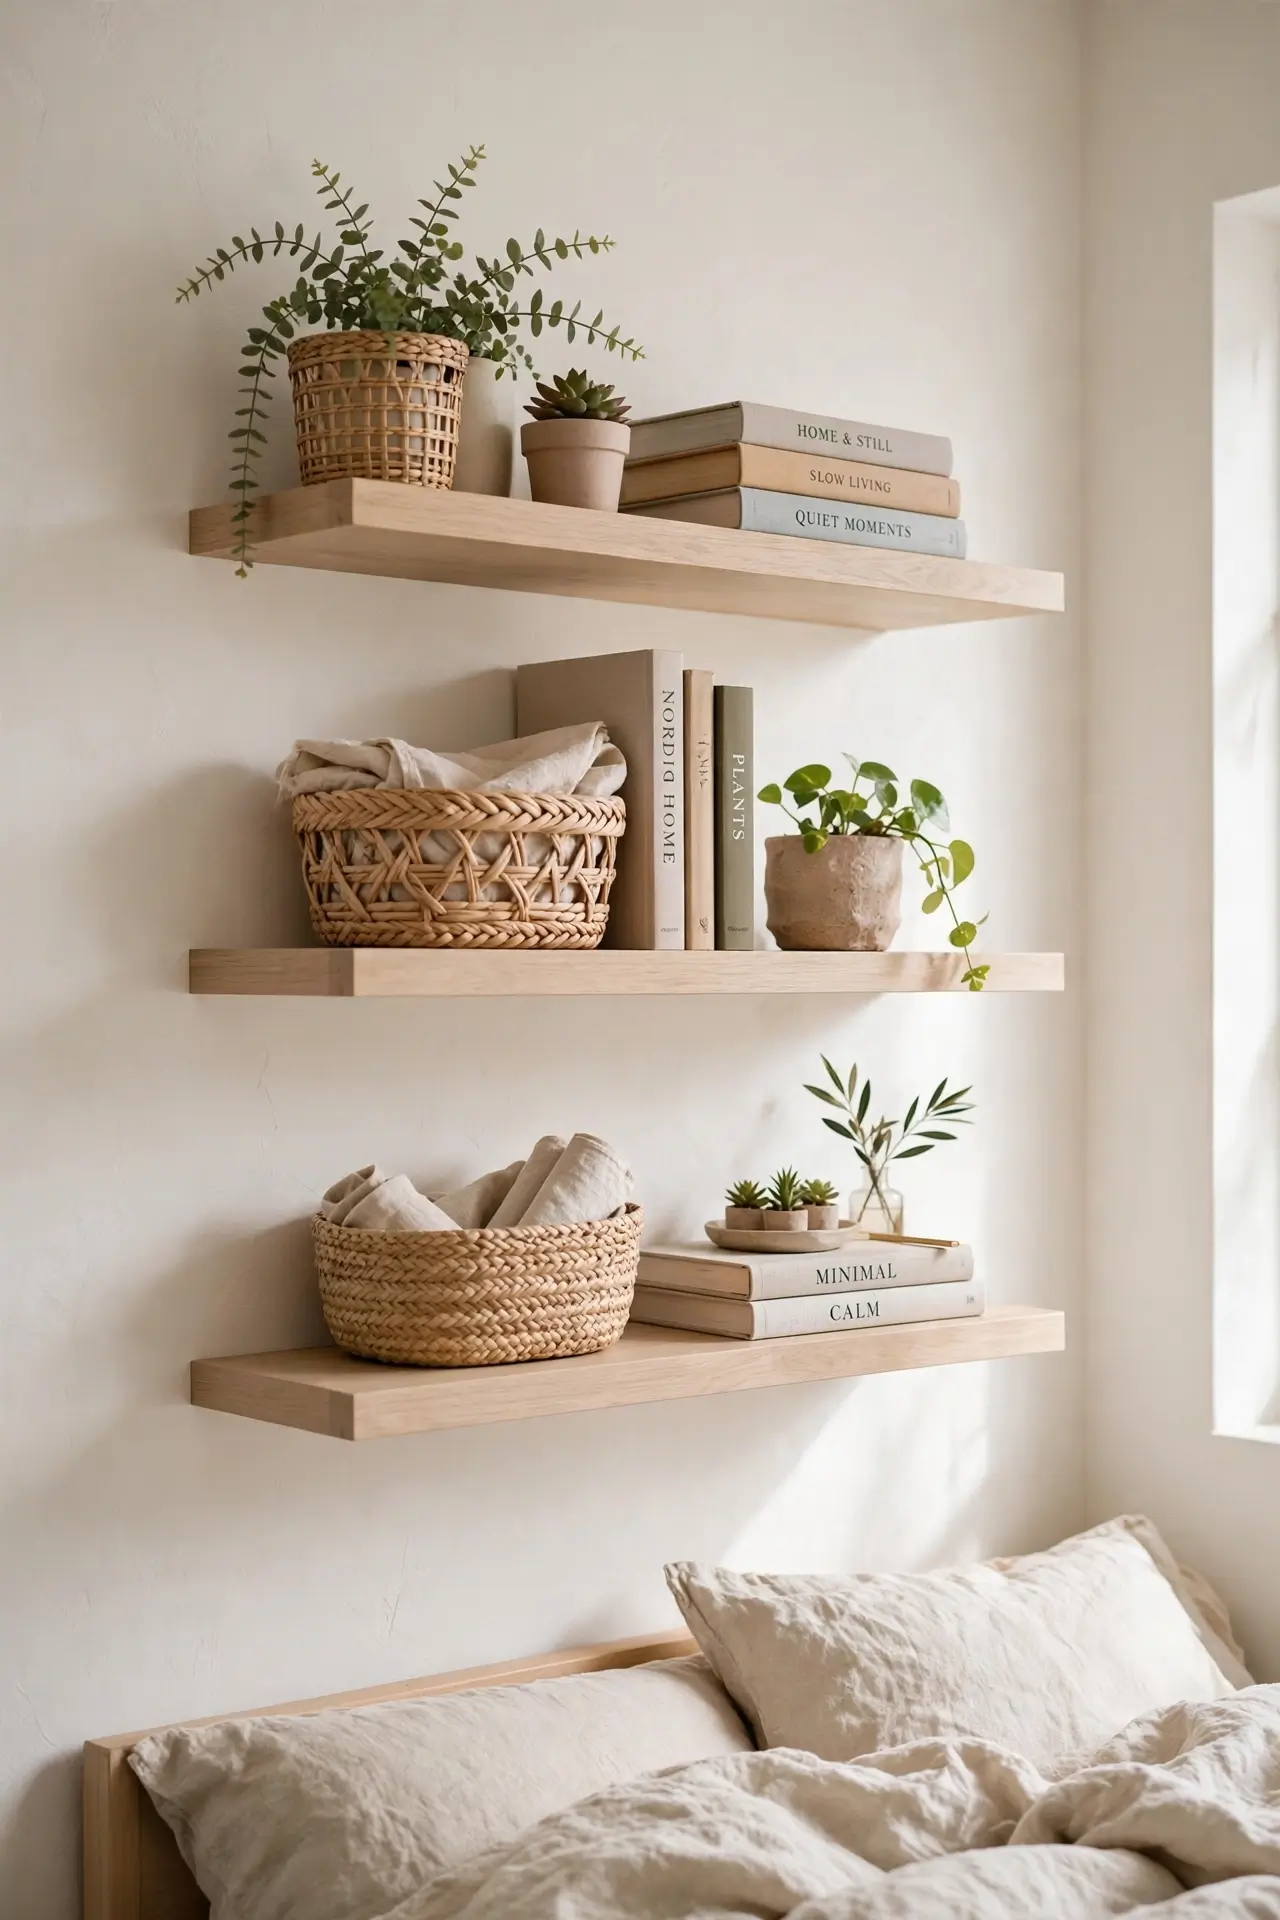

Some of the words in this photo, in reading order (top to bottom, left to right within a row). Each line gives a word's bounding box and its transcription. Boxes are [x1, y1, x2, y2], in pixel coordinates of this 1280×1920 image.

[797, 424, 838, 443] HOME
[842, 432, 852, 446] &
[856, 434, 893, 452] STILL
[809, 470, 845, 486] SLOW
[849, 475, 892, 493] LIVING
[795, 509, 840, 528] QUIET
[844, 517, 912, 538] MOMENTS
[732, 753, 745, 841] PLANTS
[663, 794, 676, 864] HOME
[816, 1263, 897, 1285] MINIMAL
[830, 1301, 881, 1321] CALM
